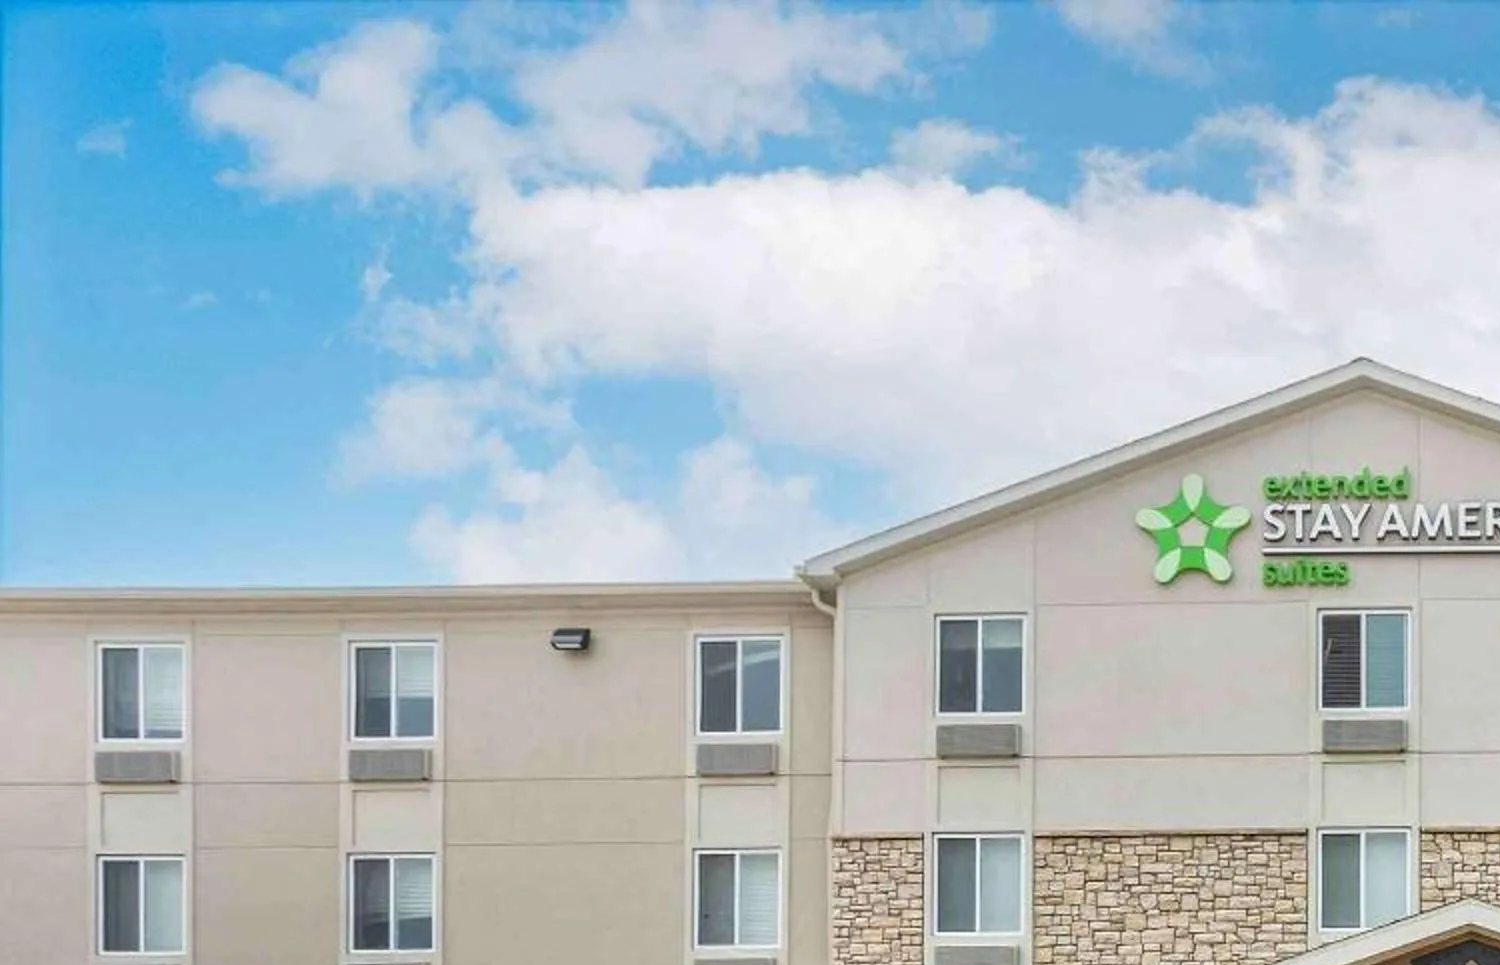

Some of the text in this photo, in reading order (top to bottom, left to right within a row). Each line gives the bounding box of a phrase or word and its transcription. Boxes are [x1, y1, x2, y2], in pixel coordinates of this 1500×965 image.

[1263, 467, 1411, 500] extended
[1263, 502, 1372, 542] STAY
[1262, 558, 1350, 586] suites
